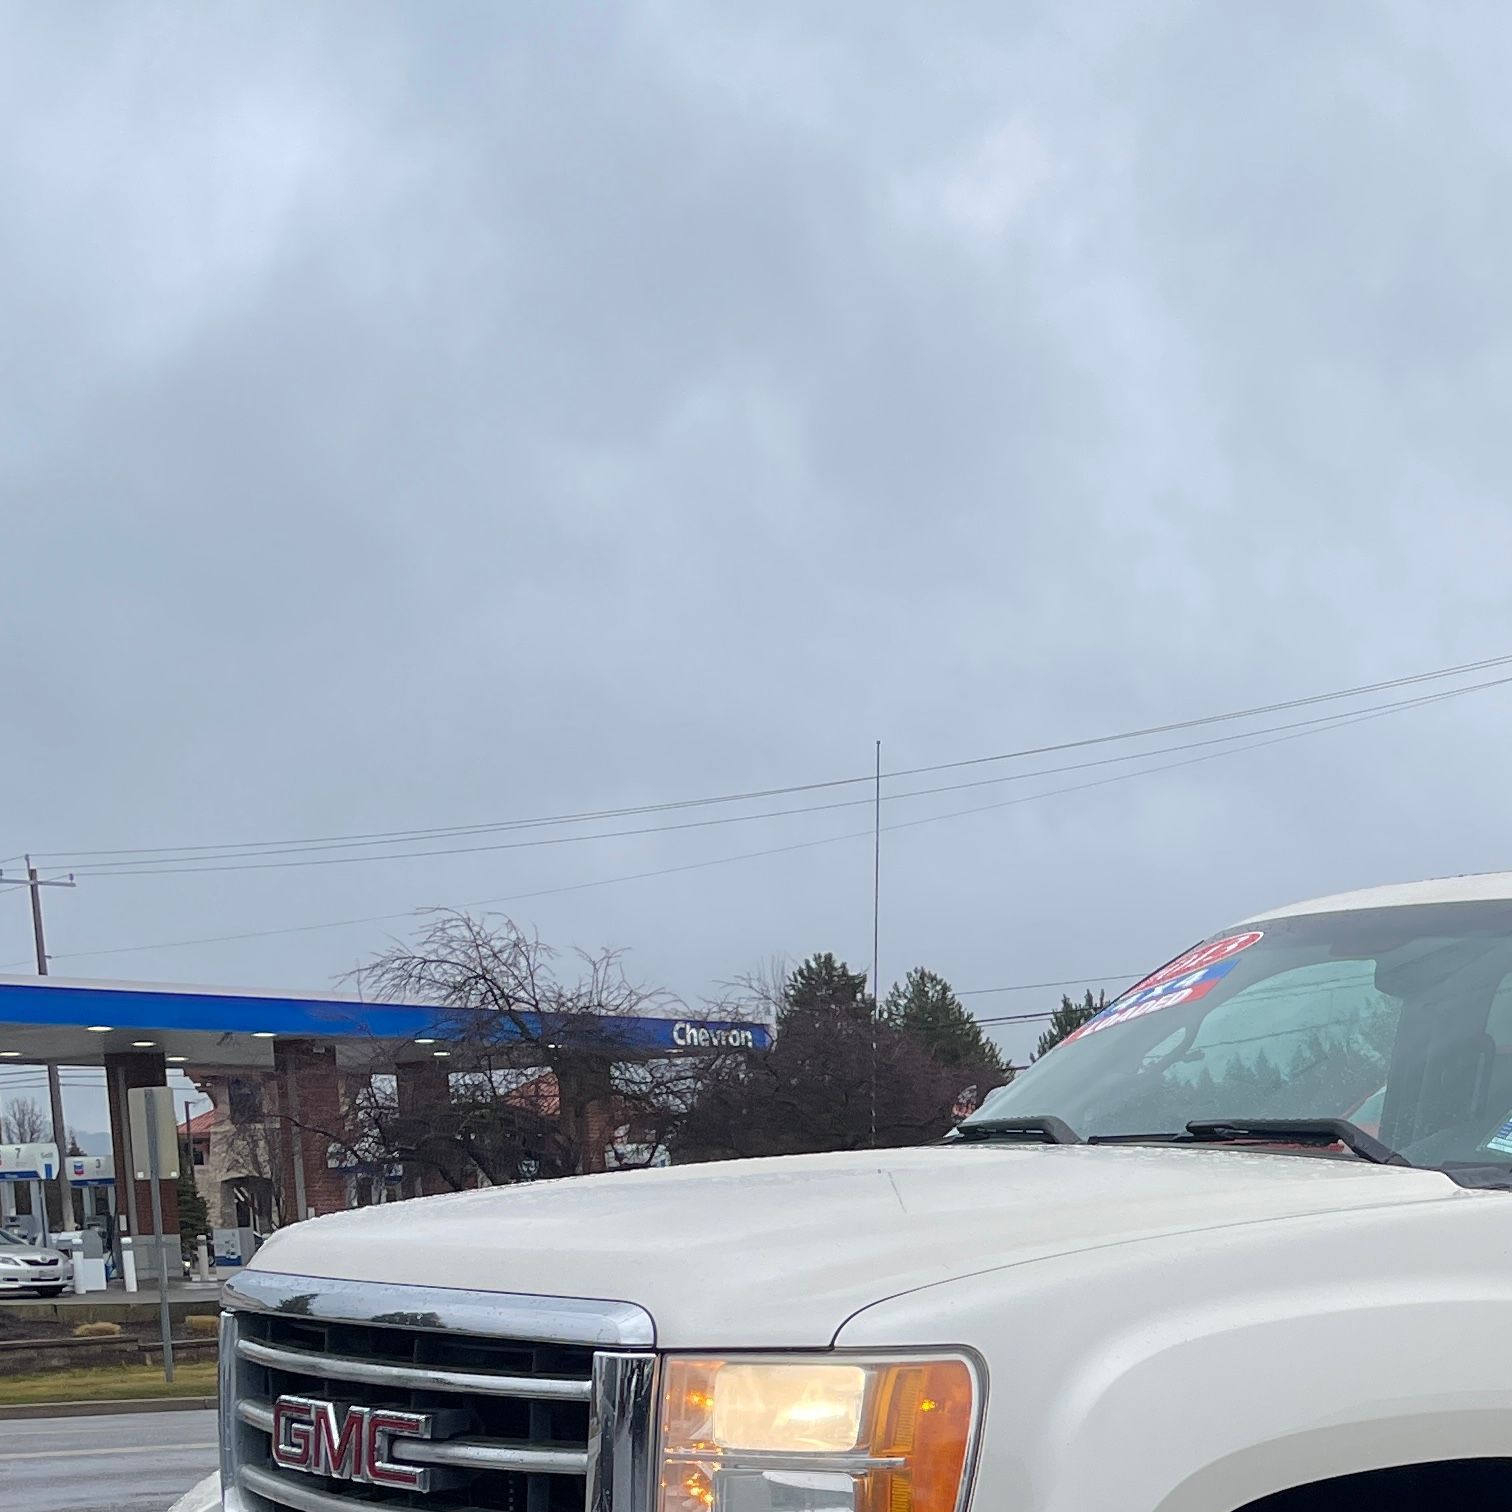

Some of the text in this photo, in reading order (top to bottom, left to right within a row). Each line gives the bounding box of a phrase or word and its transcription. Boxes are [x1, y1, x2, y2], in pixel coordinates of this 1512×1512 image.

[672, 1021, 753, 1048] Chevron
[1077, 988, 1193, 1039] LOADED
[272, 1394, 432, 1493] GMC
